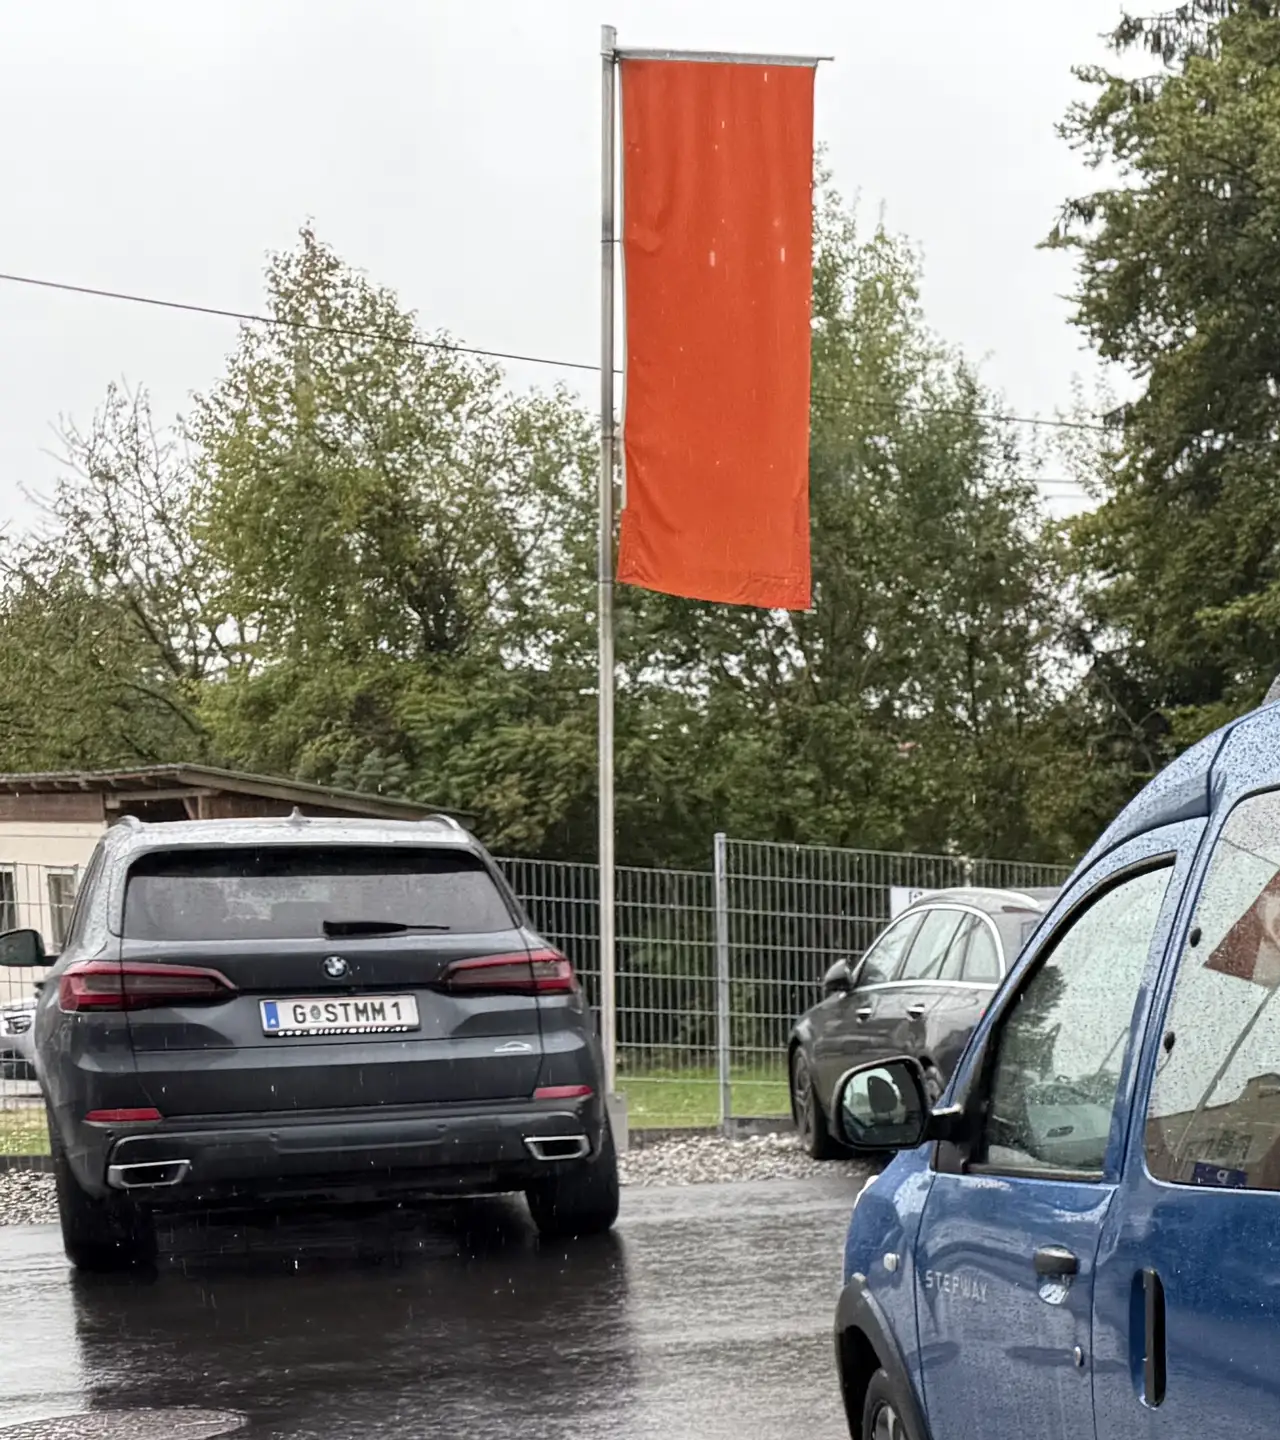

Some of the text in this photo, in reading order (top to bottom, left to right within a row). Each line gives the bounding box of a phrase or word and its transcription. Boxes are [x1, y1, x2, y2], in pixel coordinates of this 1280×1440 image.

[293, 1004, 306, 1024] G
[324, 1001, 386, 1023] STMM
[391, 1001, 402, 1020] 1
[925, 1269, 988, 1303] STEPWAY
